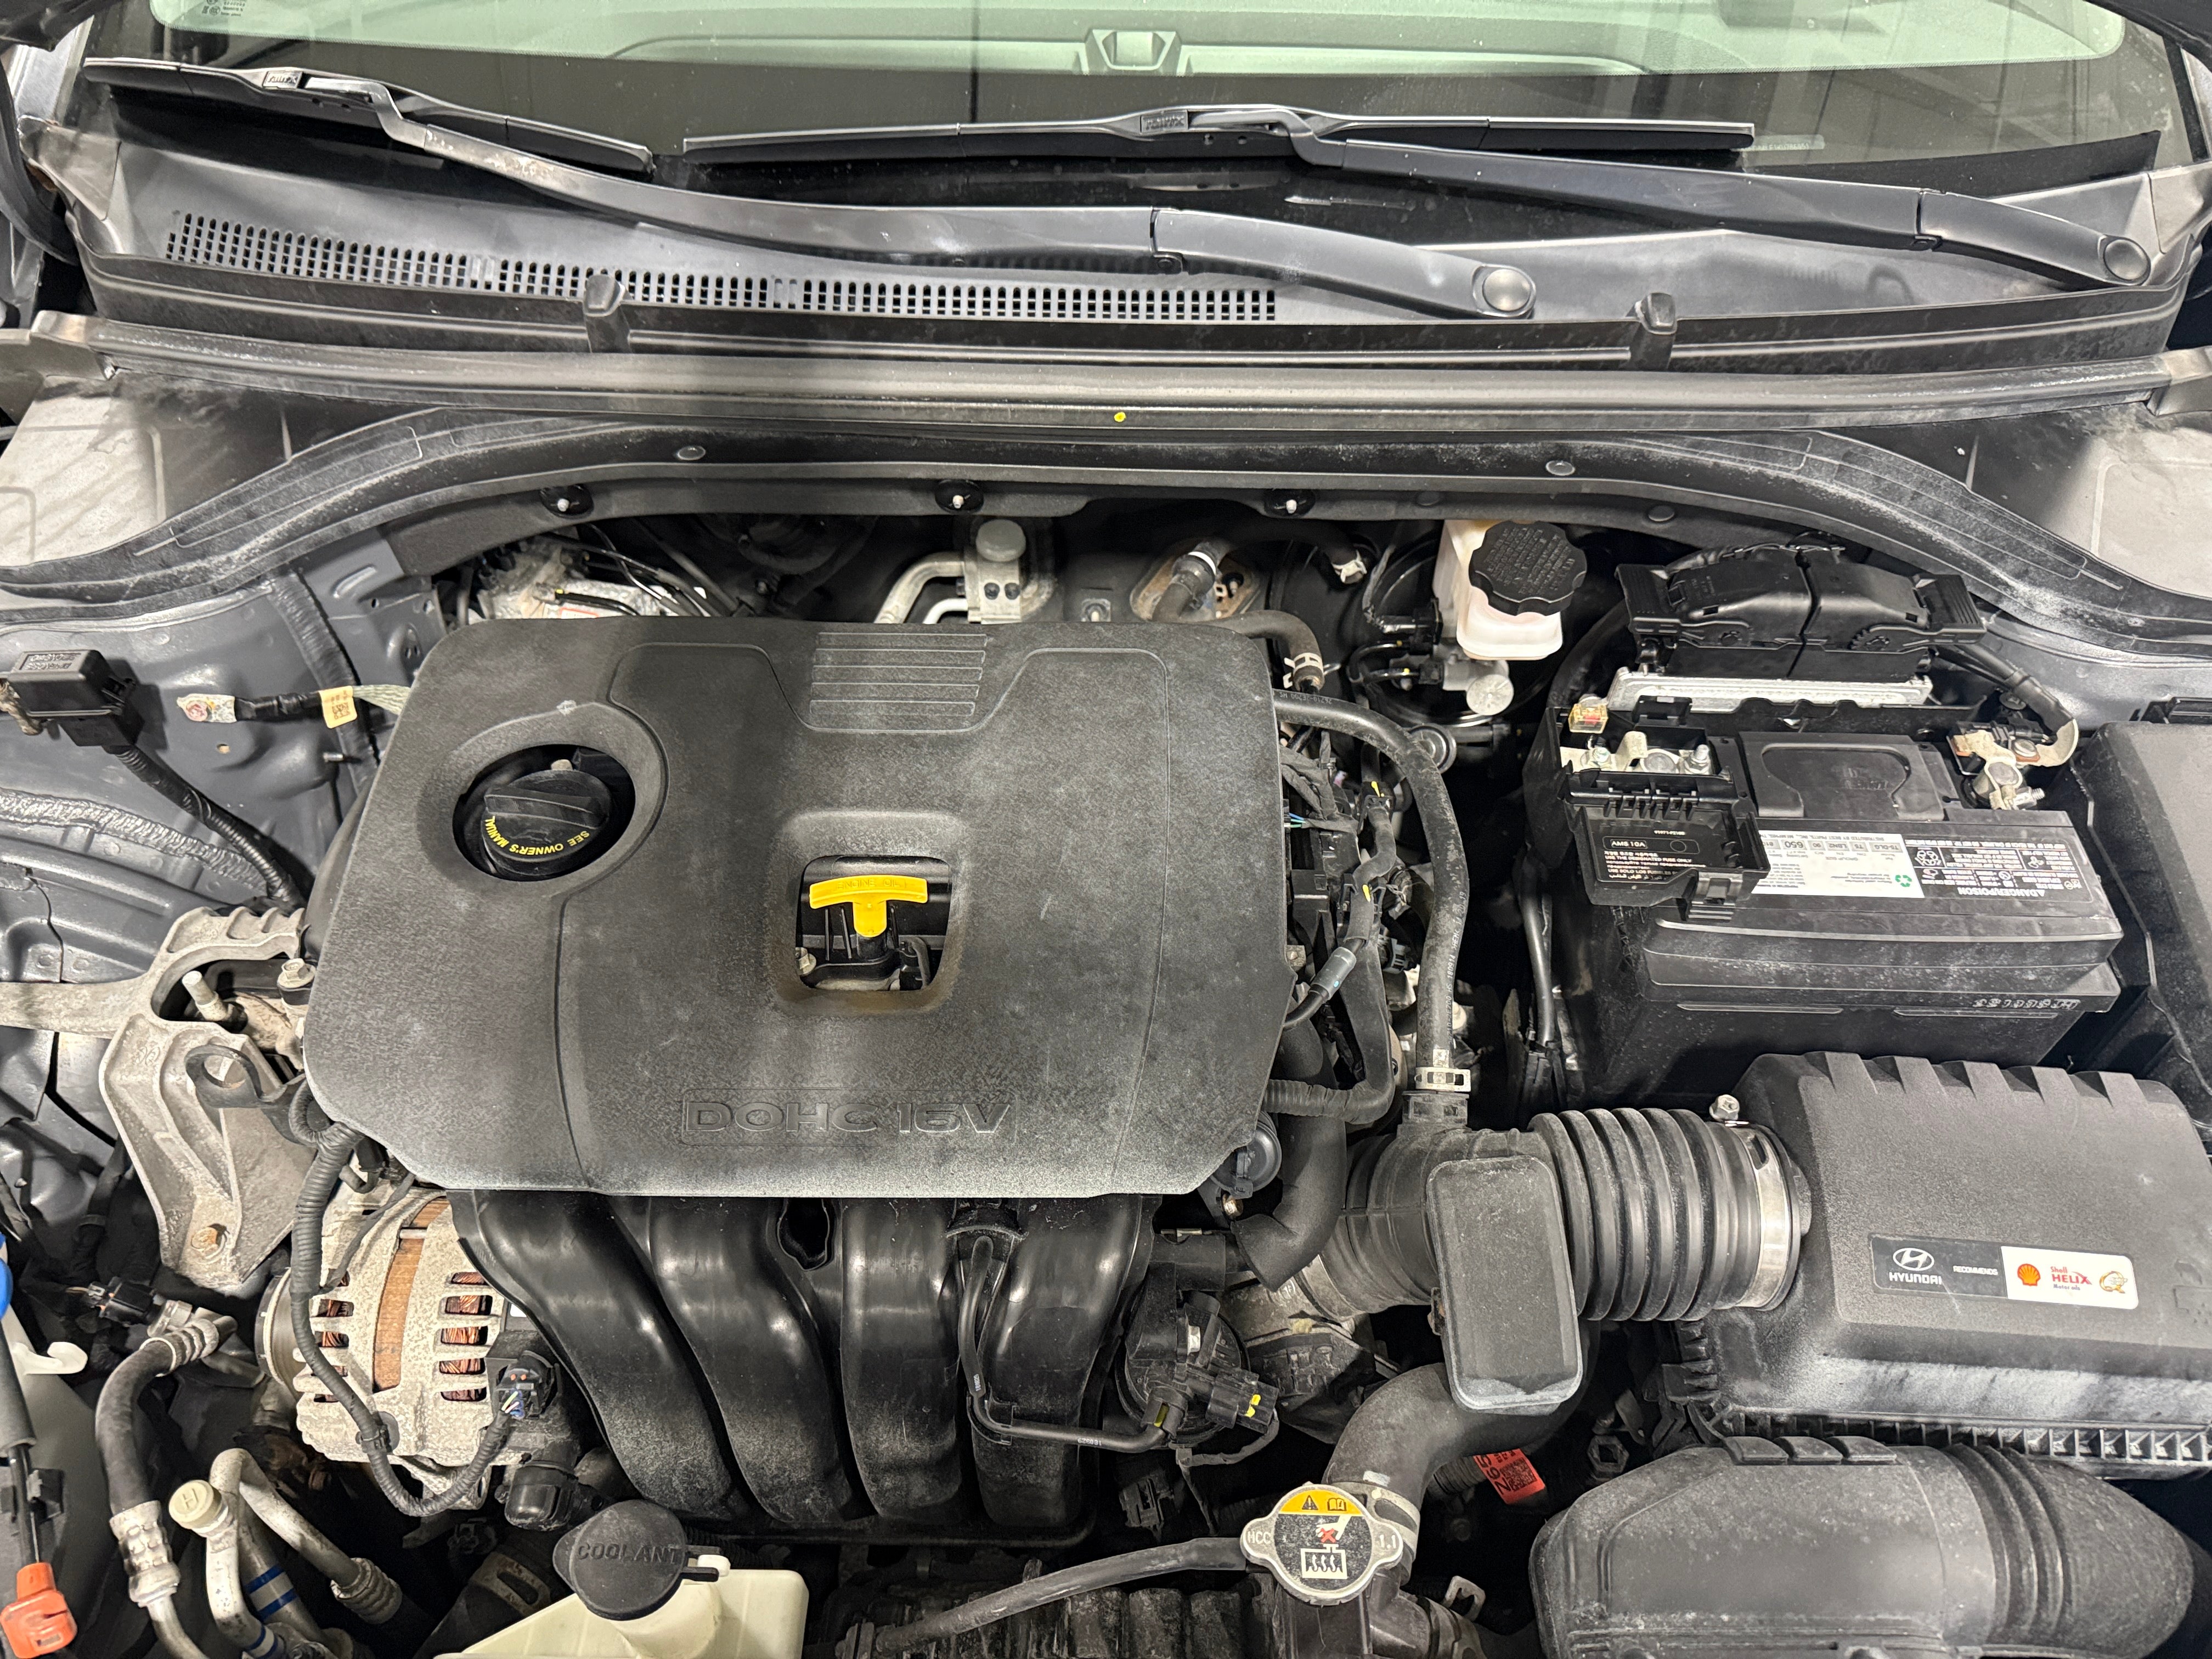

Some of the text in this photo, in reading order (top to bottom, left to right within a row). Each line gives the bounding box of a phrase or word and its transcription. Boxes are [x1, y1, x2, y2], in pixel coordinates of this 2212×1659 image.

[485, 815, 590, 855] SEE OWNER'S MANUAL
[837, 879, 900, 889] ENGINE OIL
[686, 1103, 1011, 1134] DOHC 16V
[1953, 1265, 1998, 1275] RECOMMENDS
[1889, 1272, 1942, 1285] HYUNDAI
[2051, 1272, 2092, 1285] HELIX
[1248, 1531, 1271, 1544] HCC
[578, 1543, 682, 1564] COOLANT
